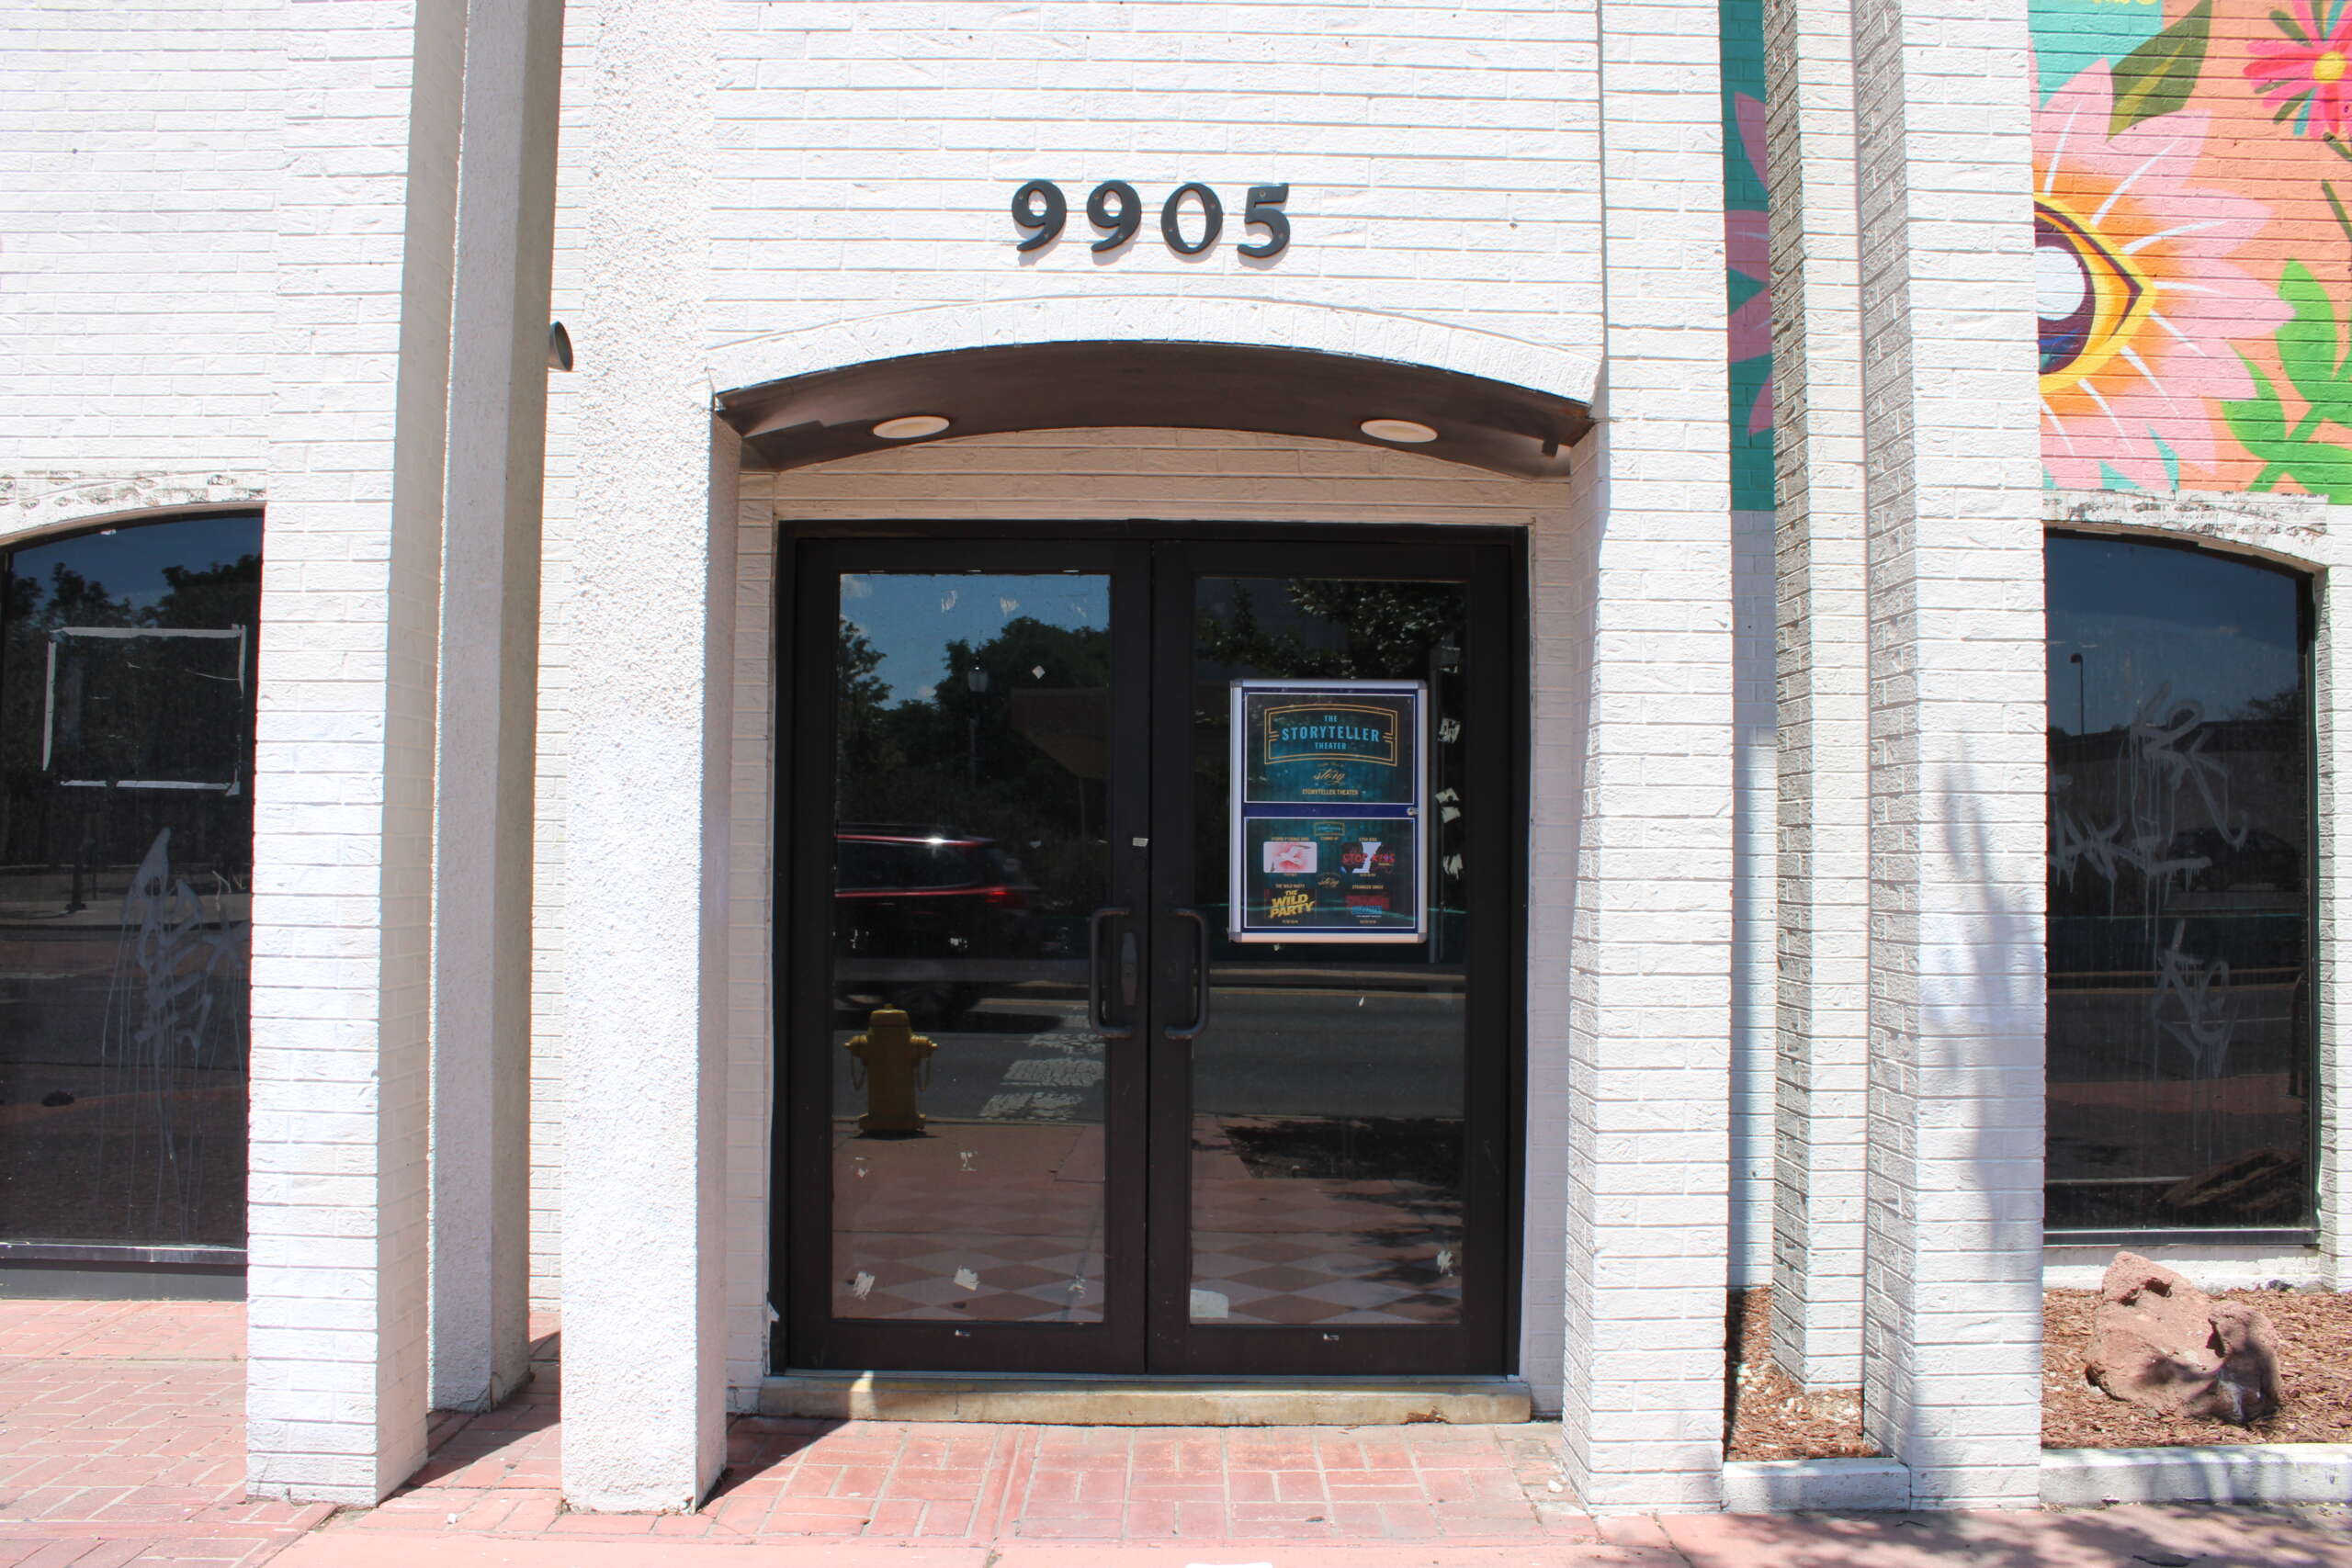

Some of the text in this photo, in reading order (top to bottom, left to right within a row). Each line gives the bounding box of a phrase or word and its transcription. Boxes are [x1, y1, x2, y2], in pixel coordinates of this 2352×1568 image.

[1011, 179, 1291, 259] 9905
[1323, 715, 1338, 723] THE
[1281, 725, 1380, 742] STORYTELLER
[1315, 741, 1347, 750] THEATER
[1342, 852, 1396, 864] STOP KISS
[1272, 894, 1309, 908] WILD
[1270, 900, 1316, 919] PARTY
